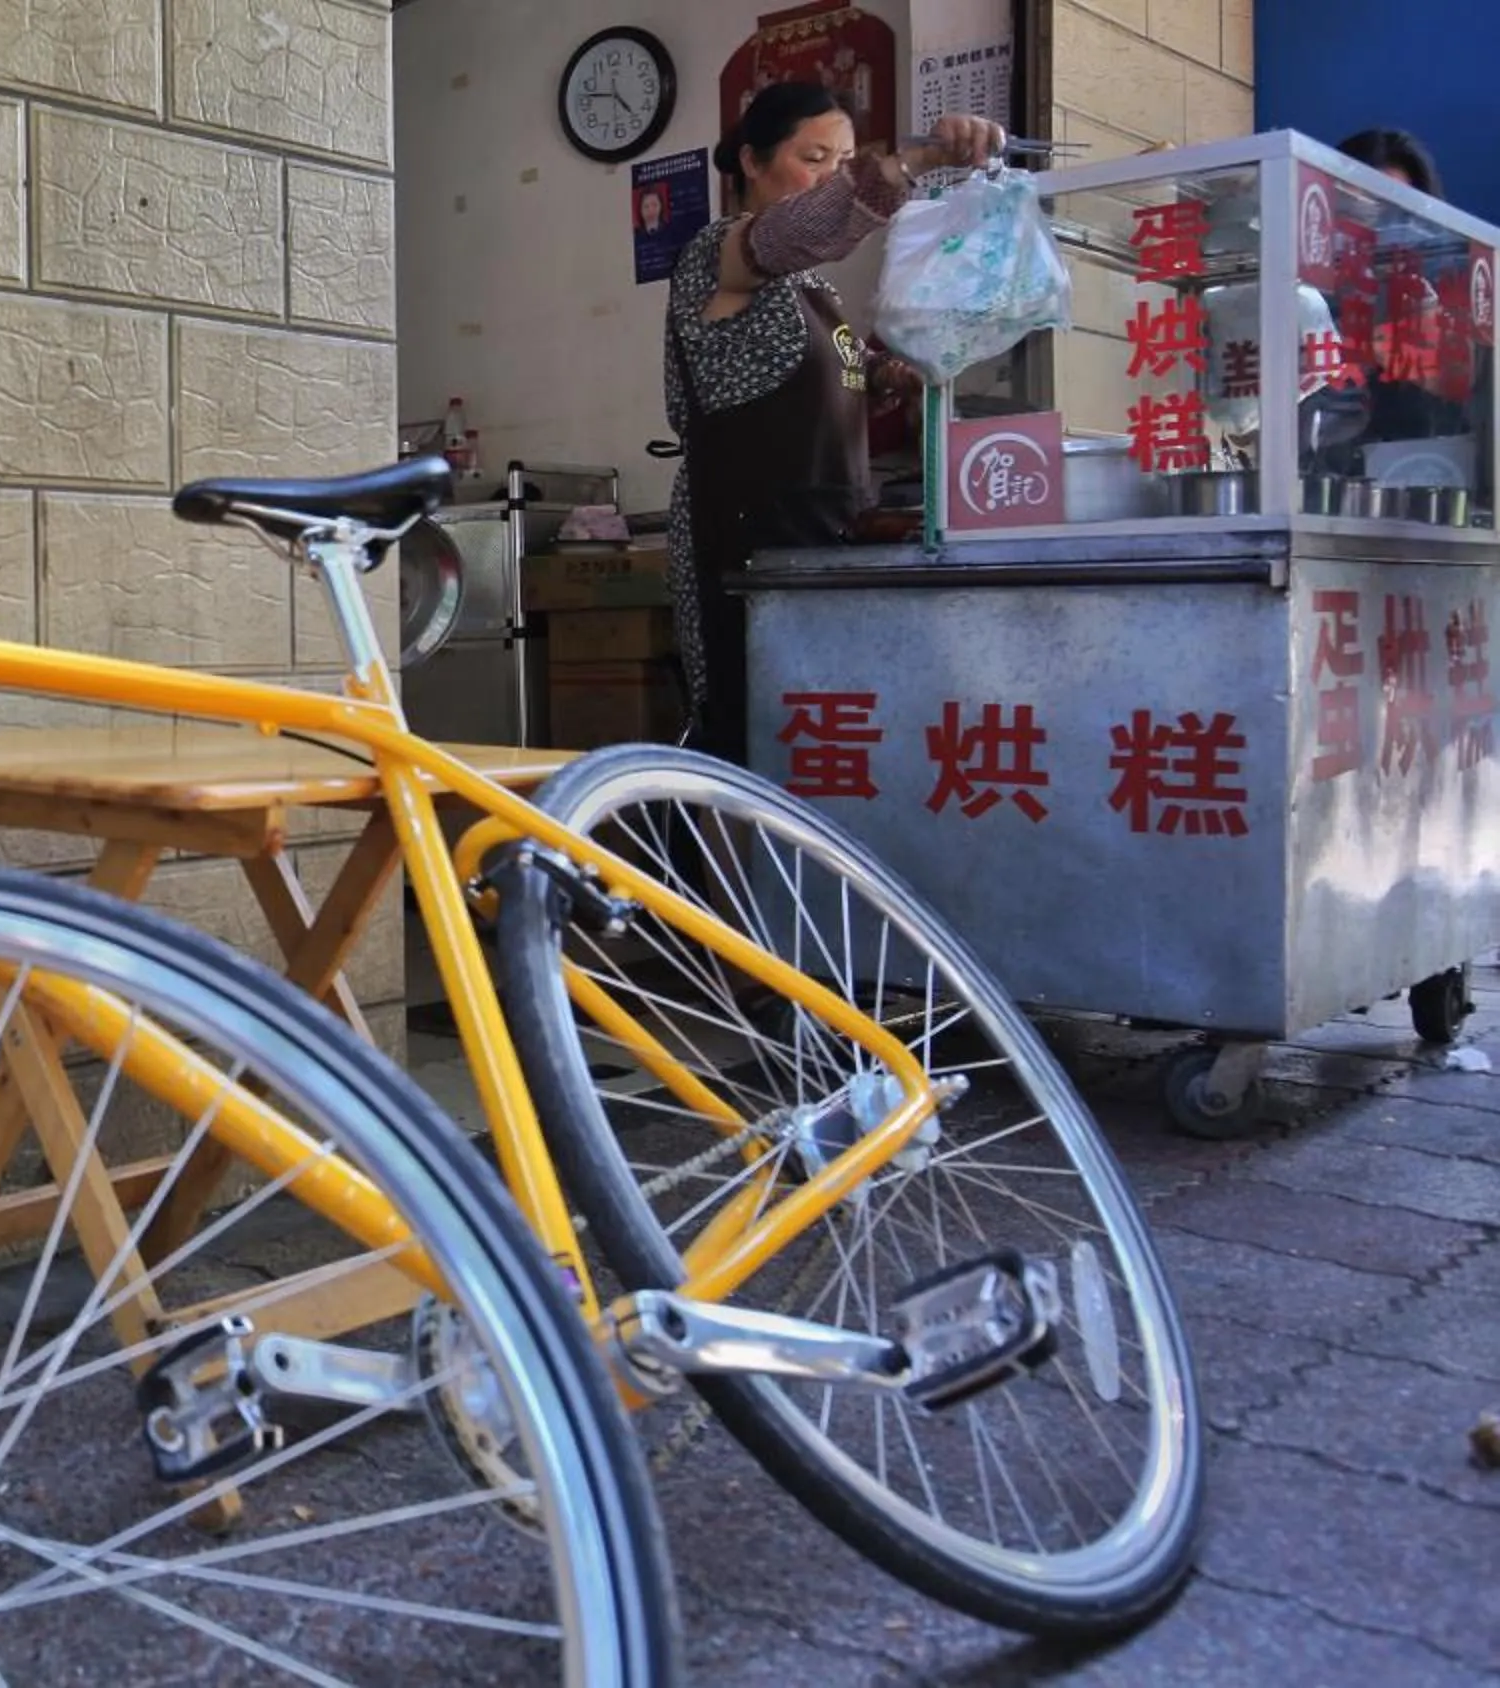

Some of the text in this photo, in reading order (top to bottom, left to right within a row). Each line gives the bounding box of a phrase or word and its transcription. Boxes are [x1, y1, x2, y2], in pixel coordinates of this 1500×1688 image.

[1125, 201, 1211, 473] 蛋烘糕
[777, 692, 1250, 838] 蛋烘糕
